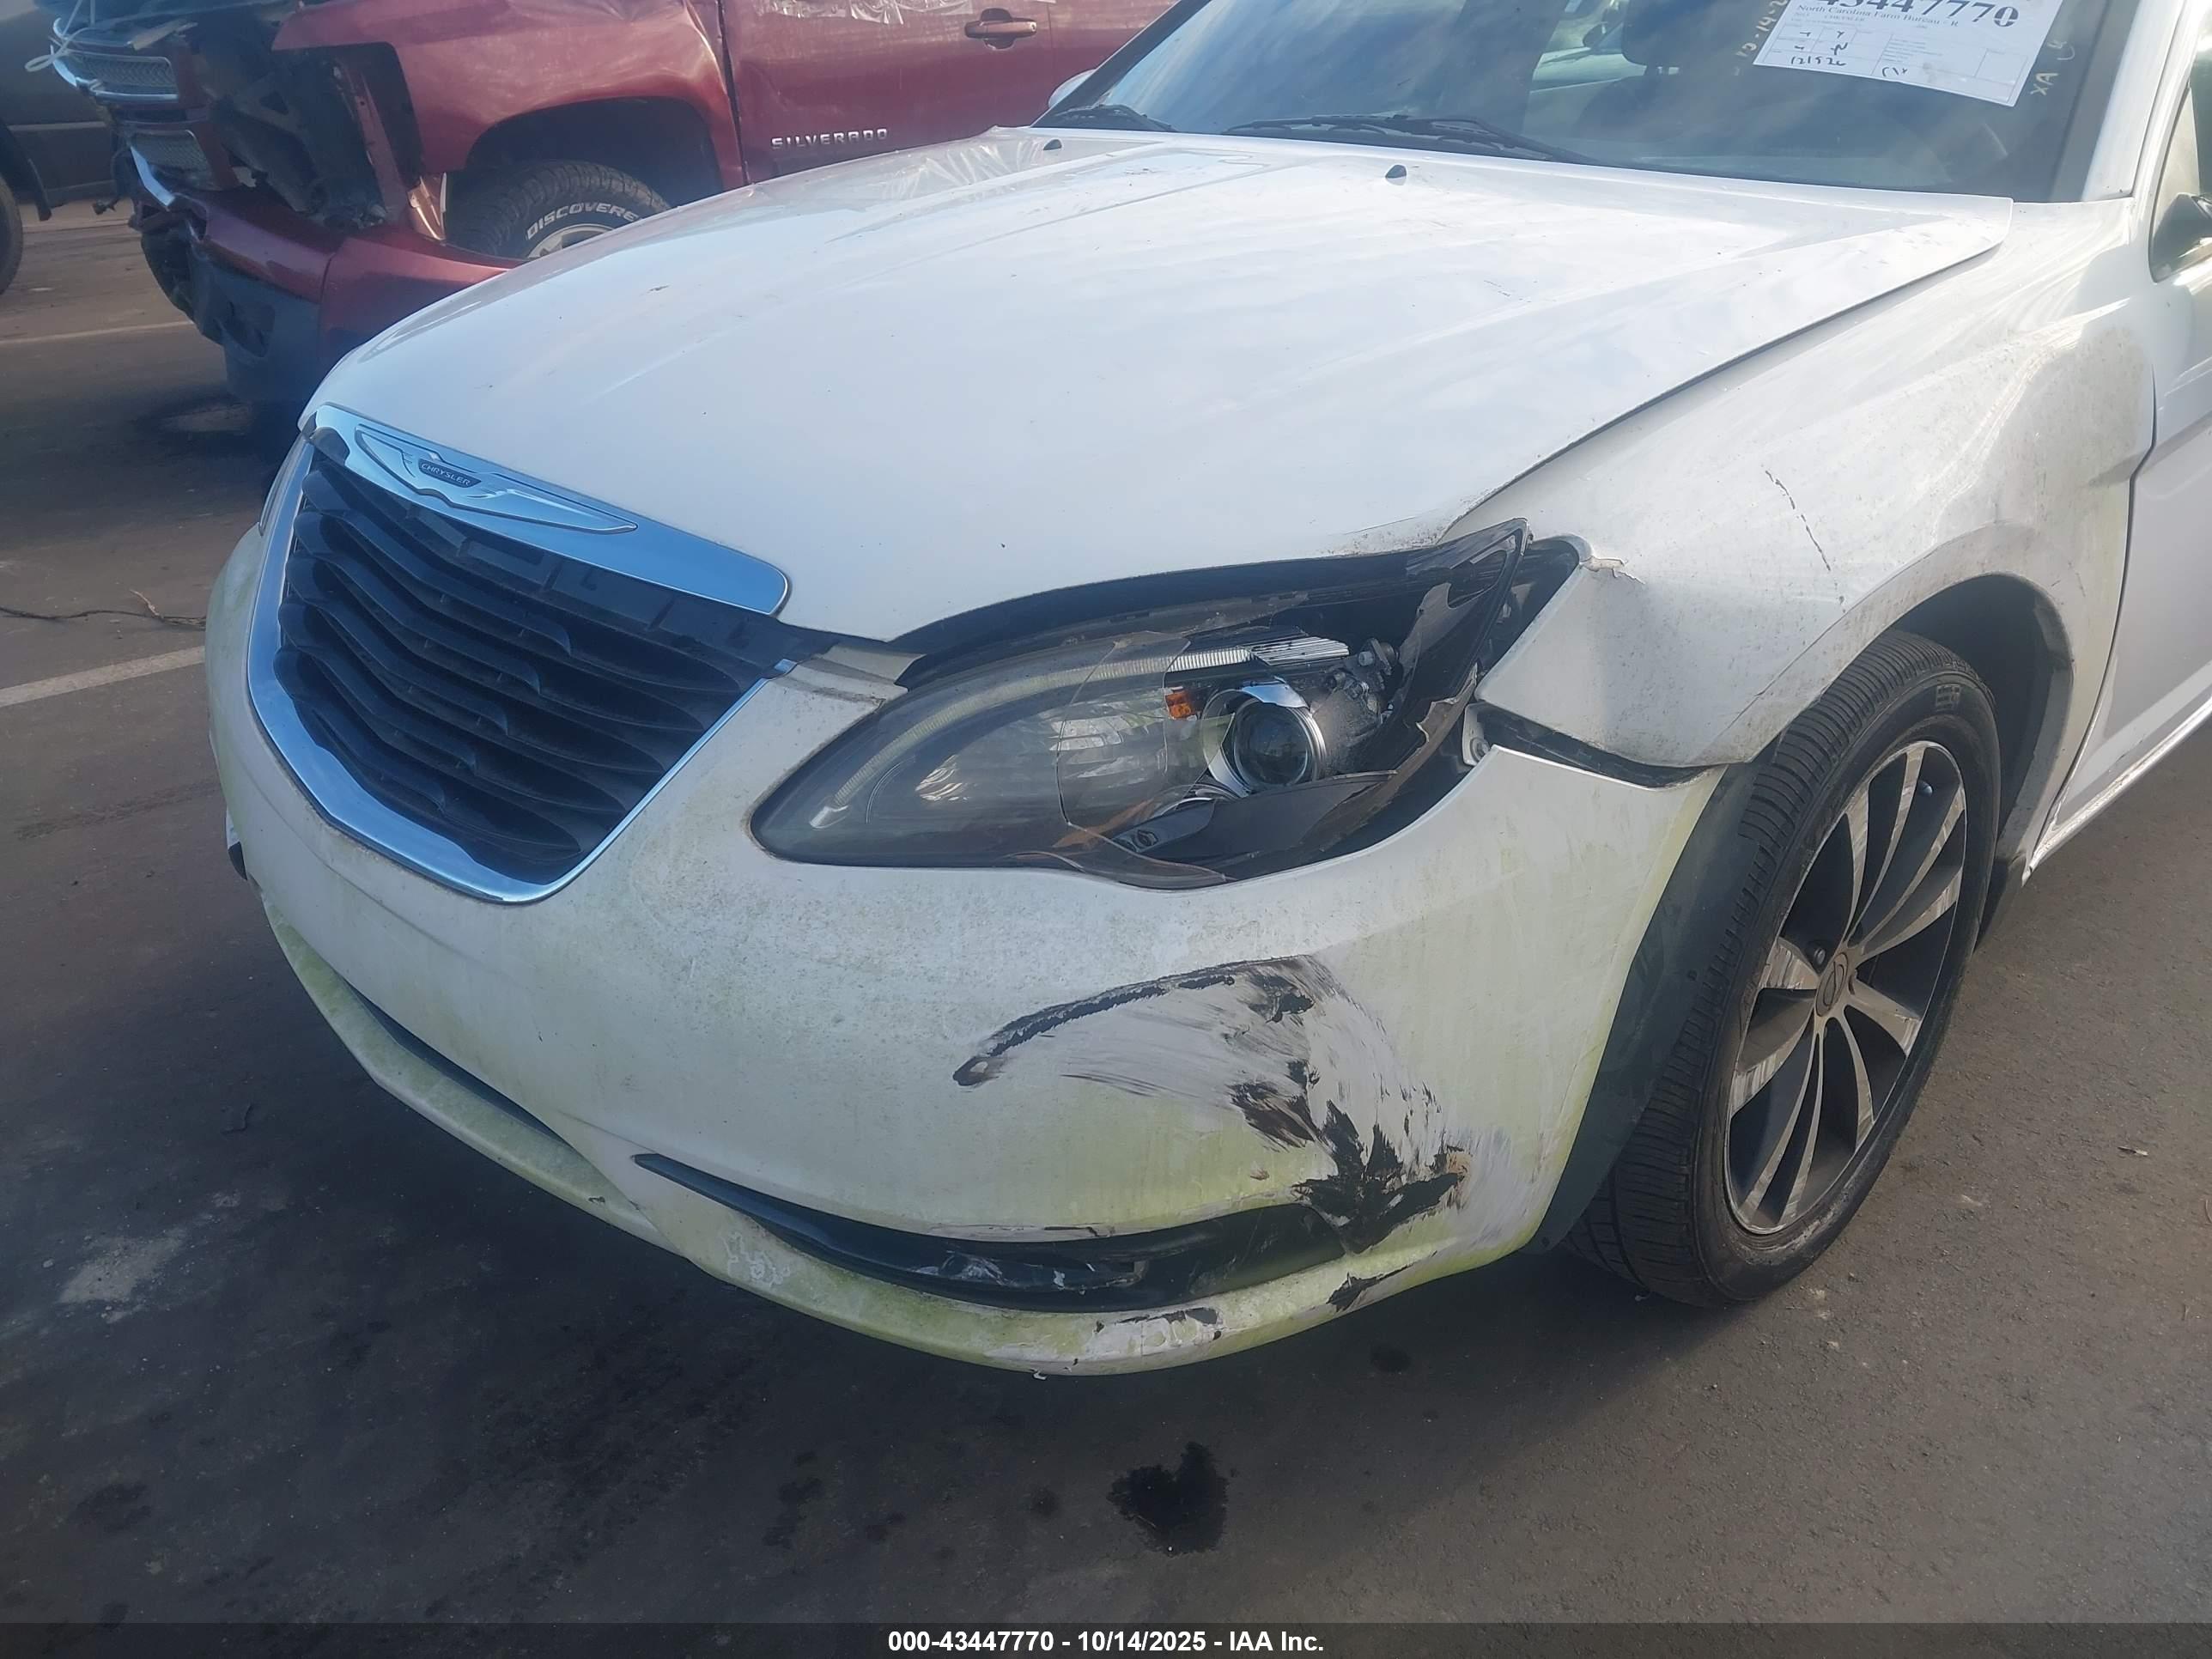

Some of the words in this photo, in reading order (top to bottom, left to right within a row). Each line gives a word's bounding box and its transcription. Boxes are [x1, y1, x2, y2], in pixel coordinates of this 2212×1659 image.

[1817, 0, 2020, 27] 447770
[1828, 7, 1871, 16] Carolina
[1904, 15, 1940, 25] Bureau
[771, 128, 888, 149] SILVERADO
[526, 201, 644, 241] DISCOVERE
[420, 463, 471, 486] CHRYSLER
